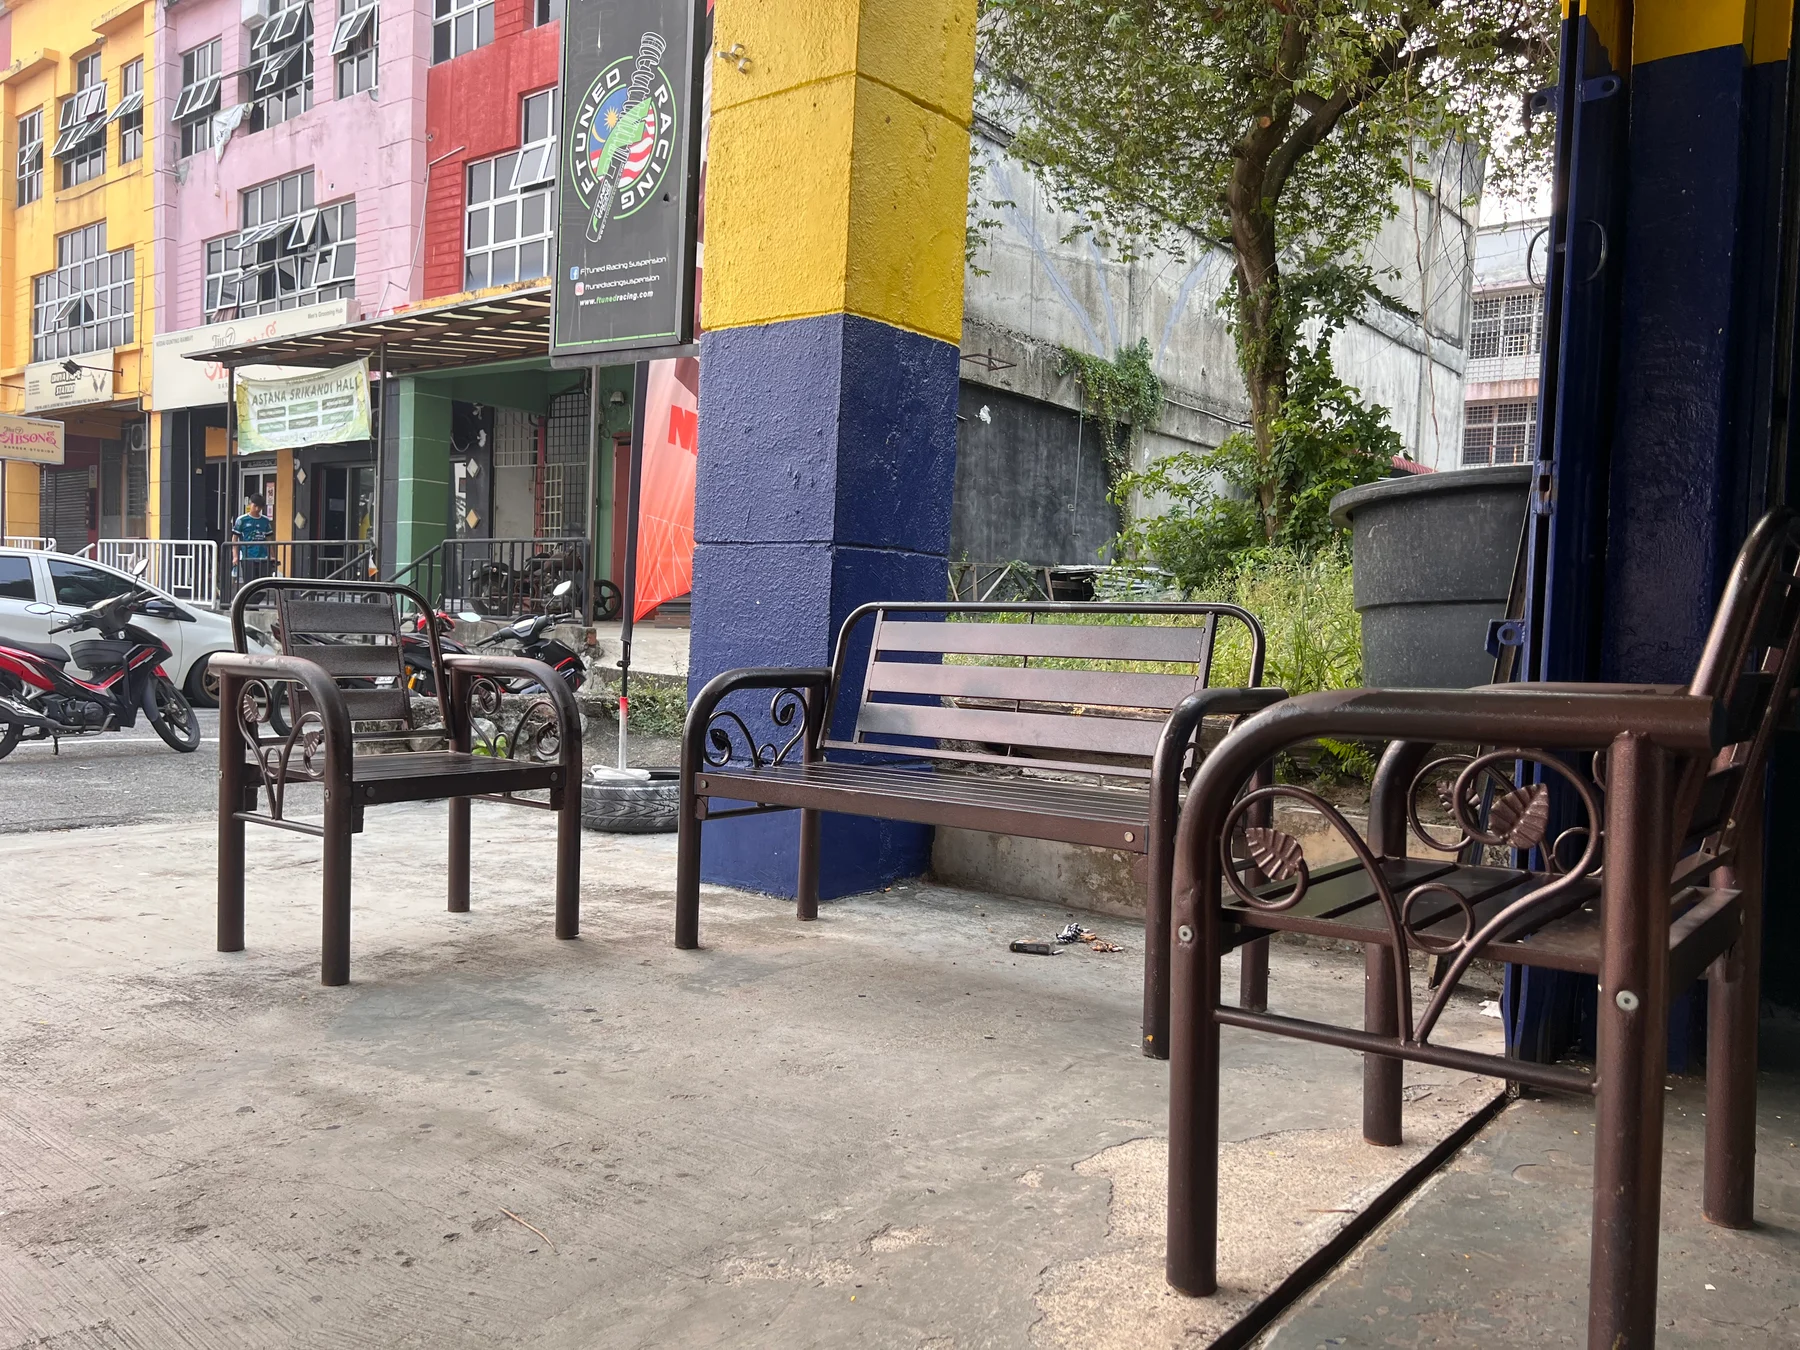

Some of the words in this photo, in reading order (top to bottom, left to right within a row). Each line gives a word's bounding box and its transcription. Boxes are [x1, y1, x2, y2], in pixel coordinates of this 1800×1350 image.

[575, 68, 621, 195] FTUNED
[620, 84, 672, 210] RACING
[606, 262, 628, 271] Racing
[628, 256, 667, 268] Suspension
[579, 290, 654, 306] www.ftunedracing.com
[252, 390, 287, 406] ASTANA
[290, 382, 333, 400] SRIKANDI
